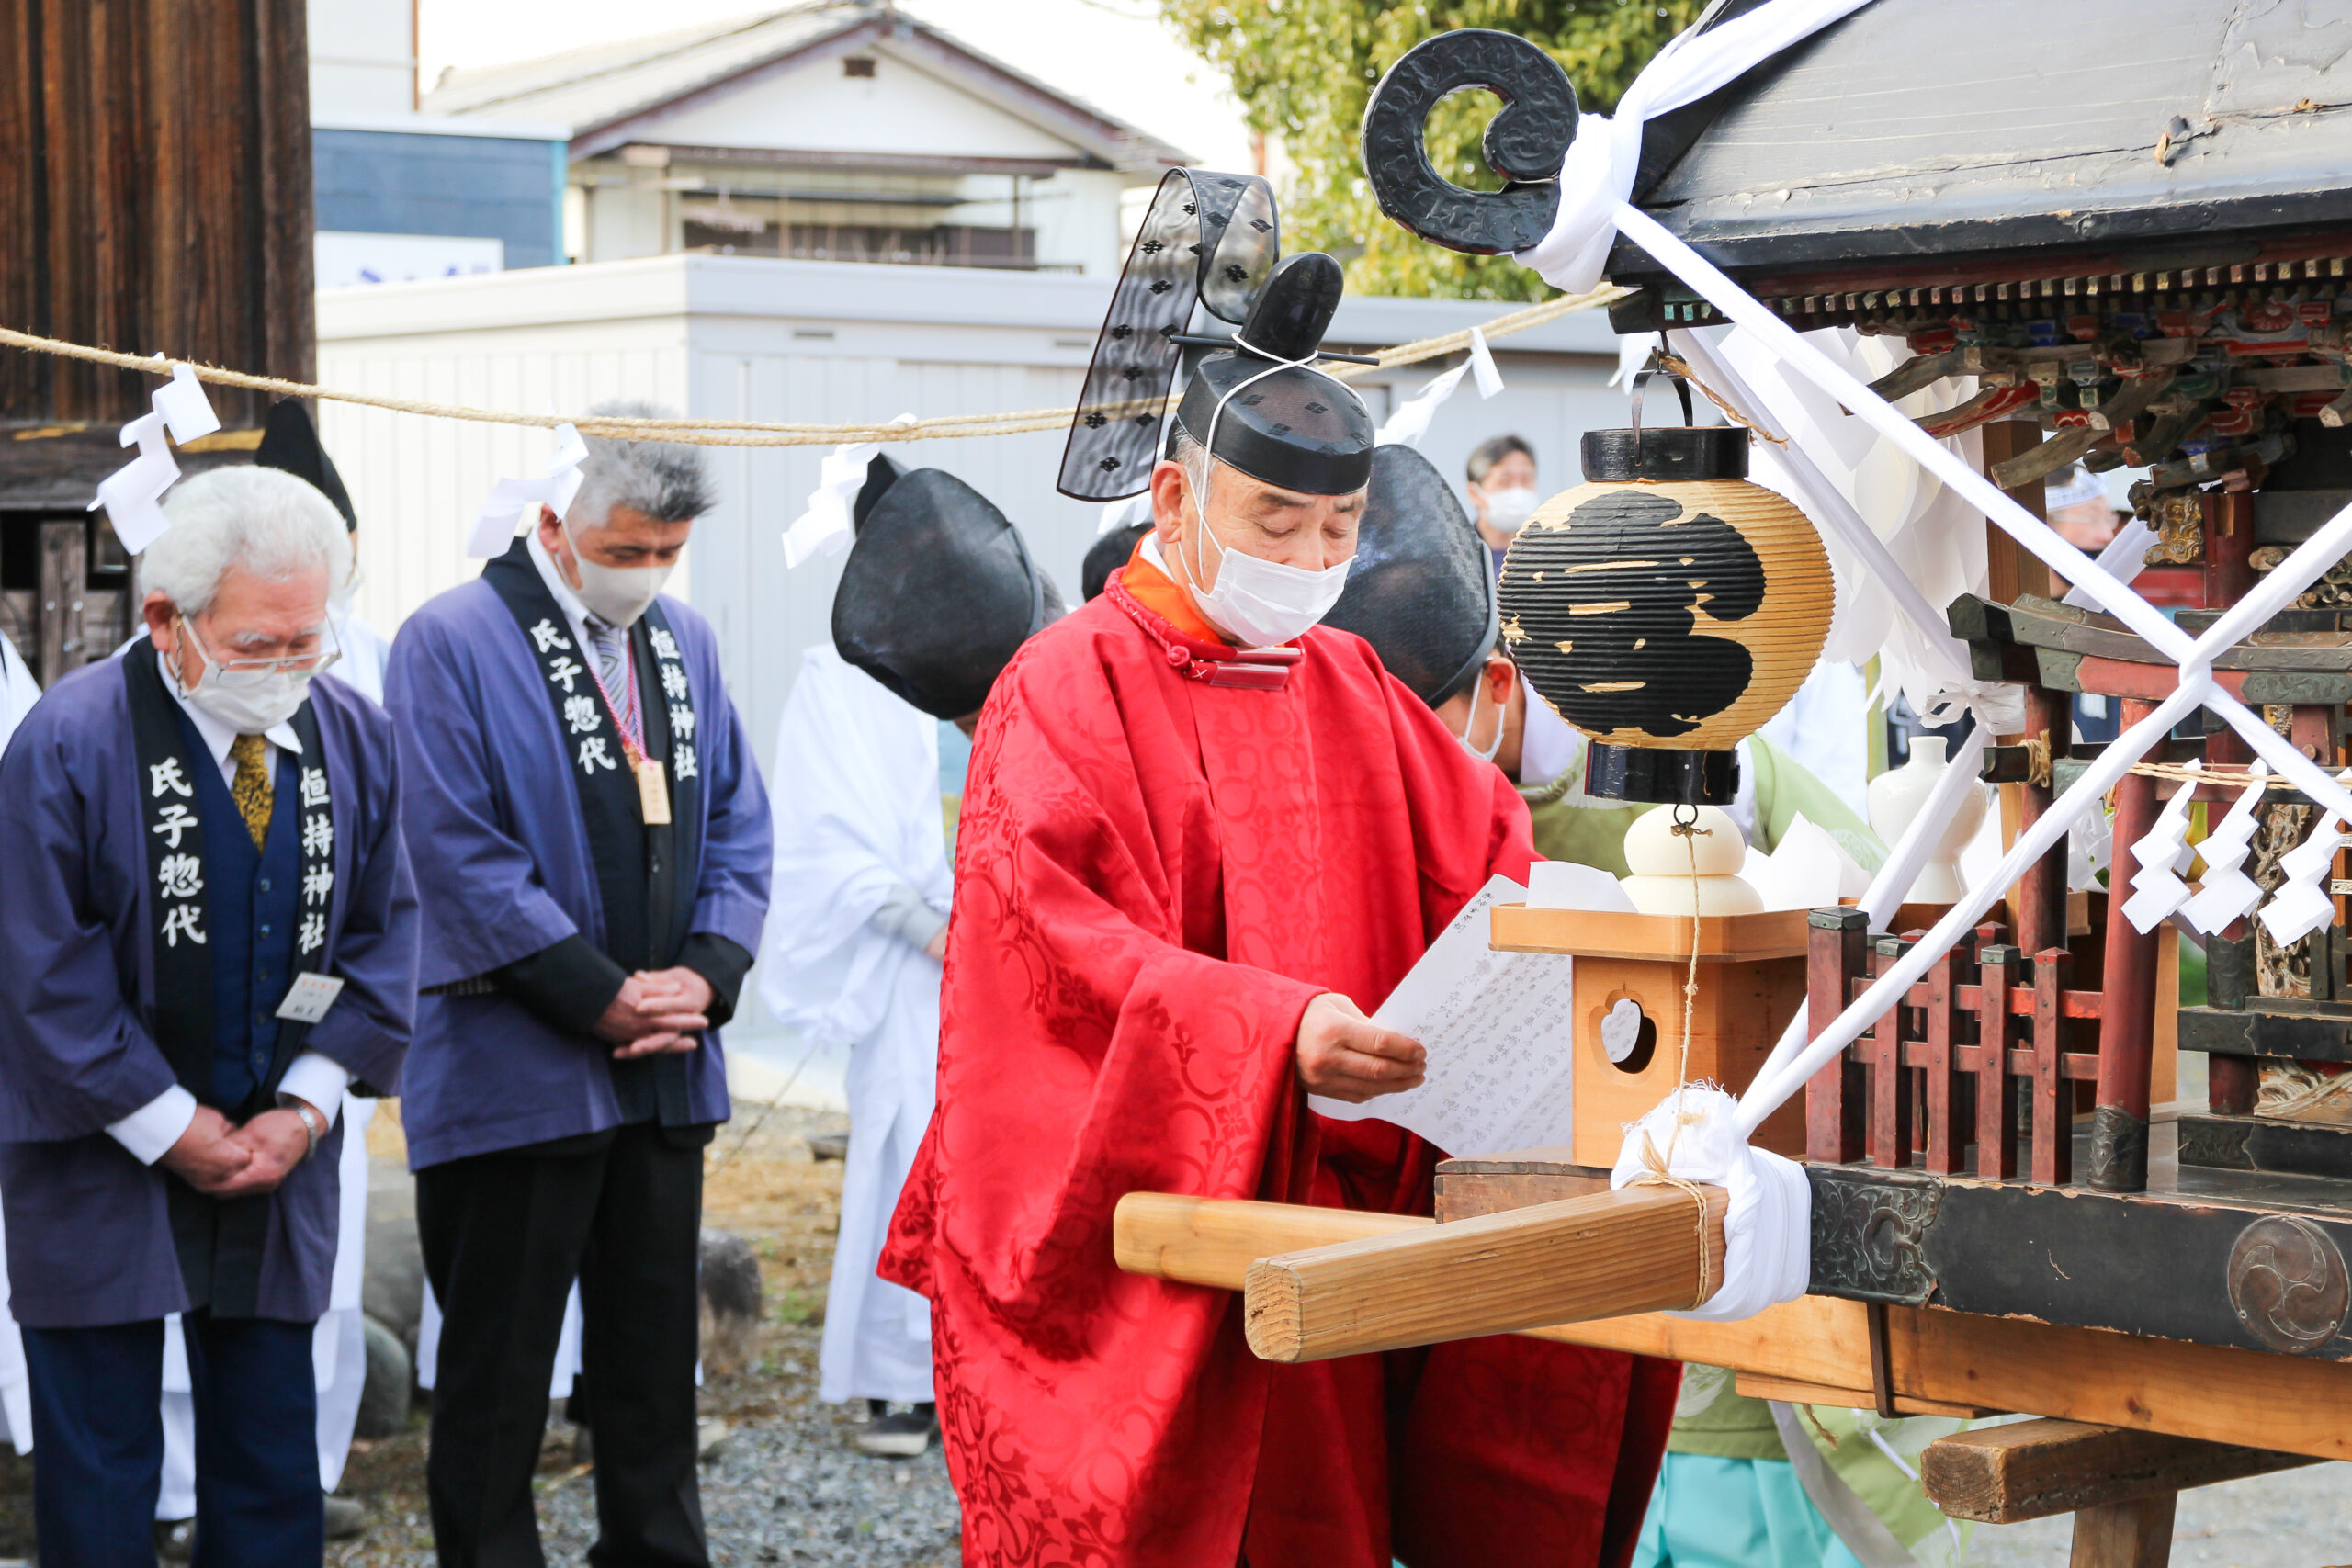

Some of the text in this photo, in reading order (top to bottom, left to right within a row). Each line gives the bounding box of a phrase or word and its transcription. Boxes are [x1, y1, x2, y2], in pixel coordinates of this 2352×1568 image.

[529, 618, 617, 775] 氏子惣代
[650, 626, 698, 782] 恒持神社
[149, 756, 207, 948] 氏子惣代
[297, 766, 334, 956] 恒持神社
